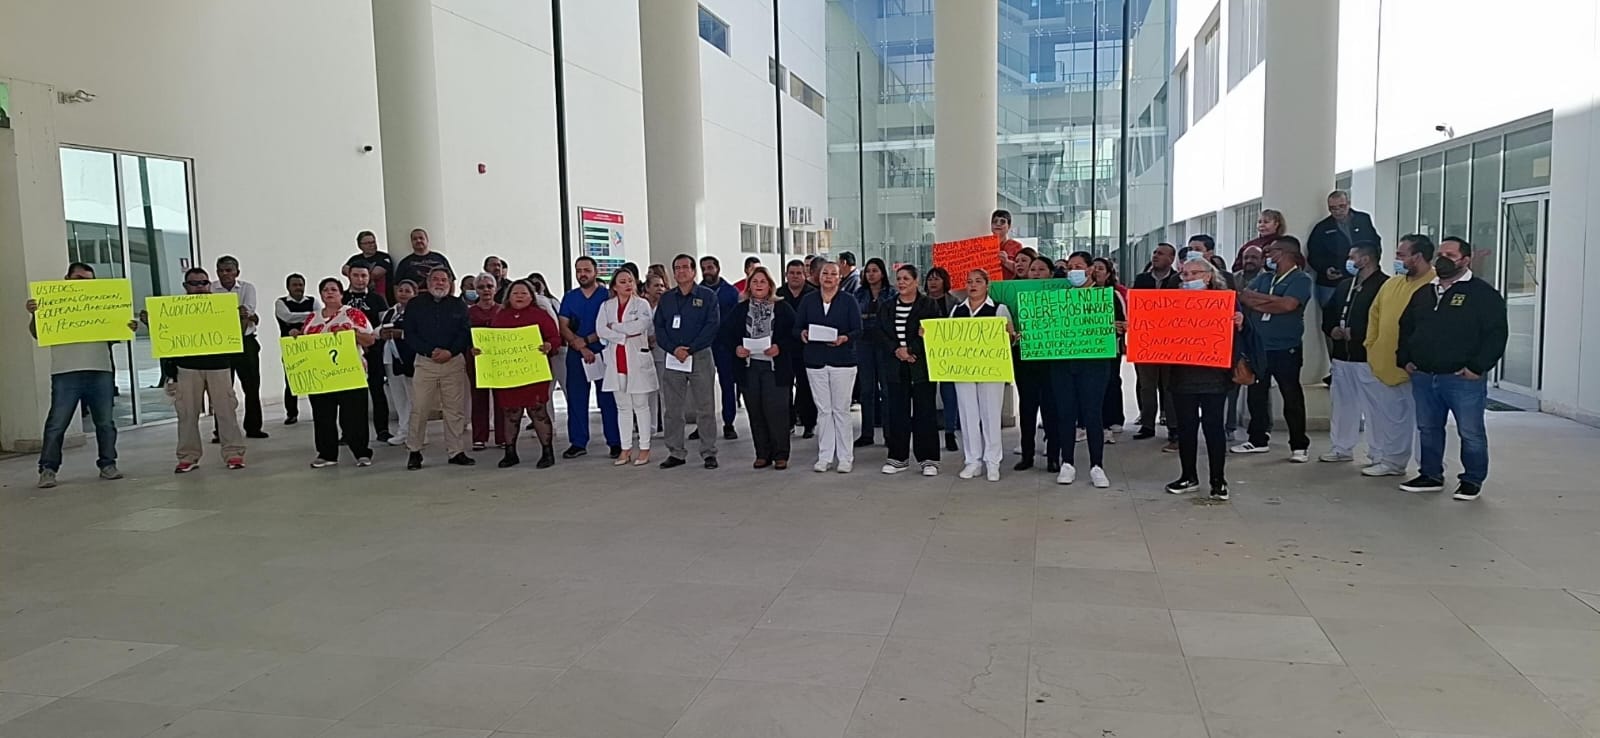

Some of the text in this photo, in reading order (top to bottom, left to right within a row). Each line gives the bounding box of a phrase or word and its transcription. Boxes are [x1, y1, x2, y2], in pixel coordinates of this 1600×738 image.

[1019, 287, 1112, 305] RAFAELA NO TE
[1134, 296, 1231, 311] DONDE ESTAN
[1018, 302, 1082, 320] QUEREMOS
[933, 320, 1006, 345] AUDITORIA
[1133, 316, 1227, 333] LAS LICENCIAS
[1044, 328, 1076, 340] TIENES
[328, 349, 340, 366] ?
[957, 346, 1010, 360] LICENCIAS
